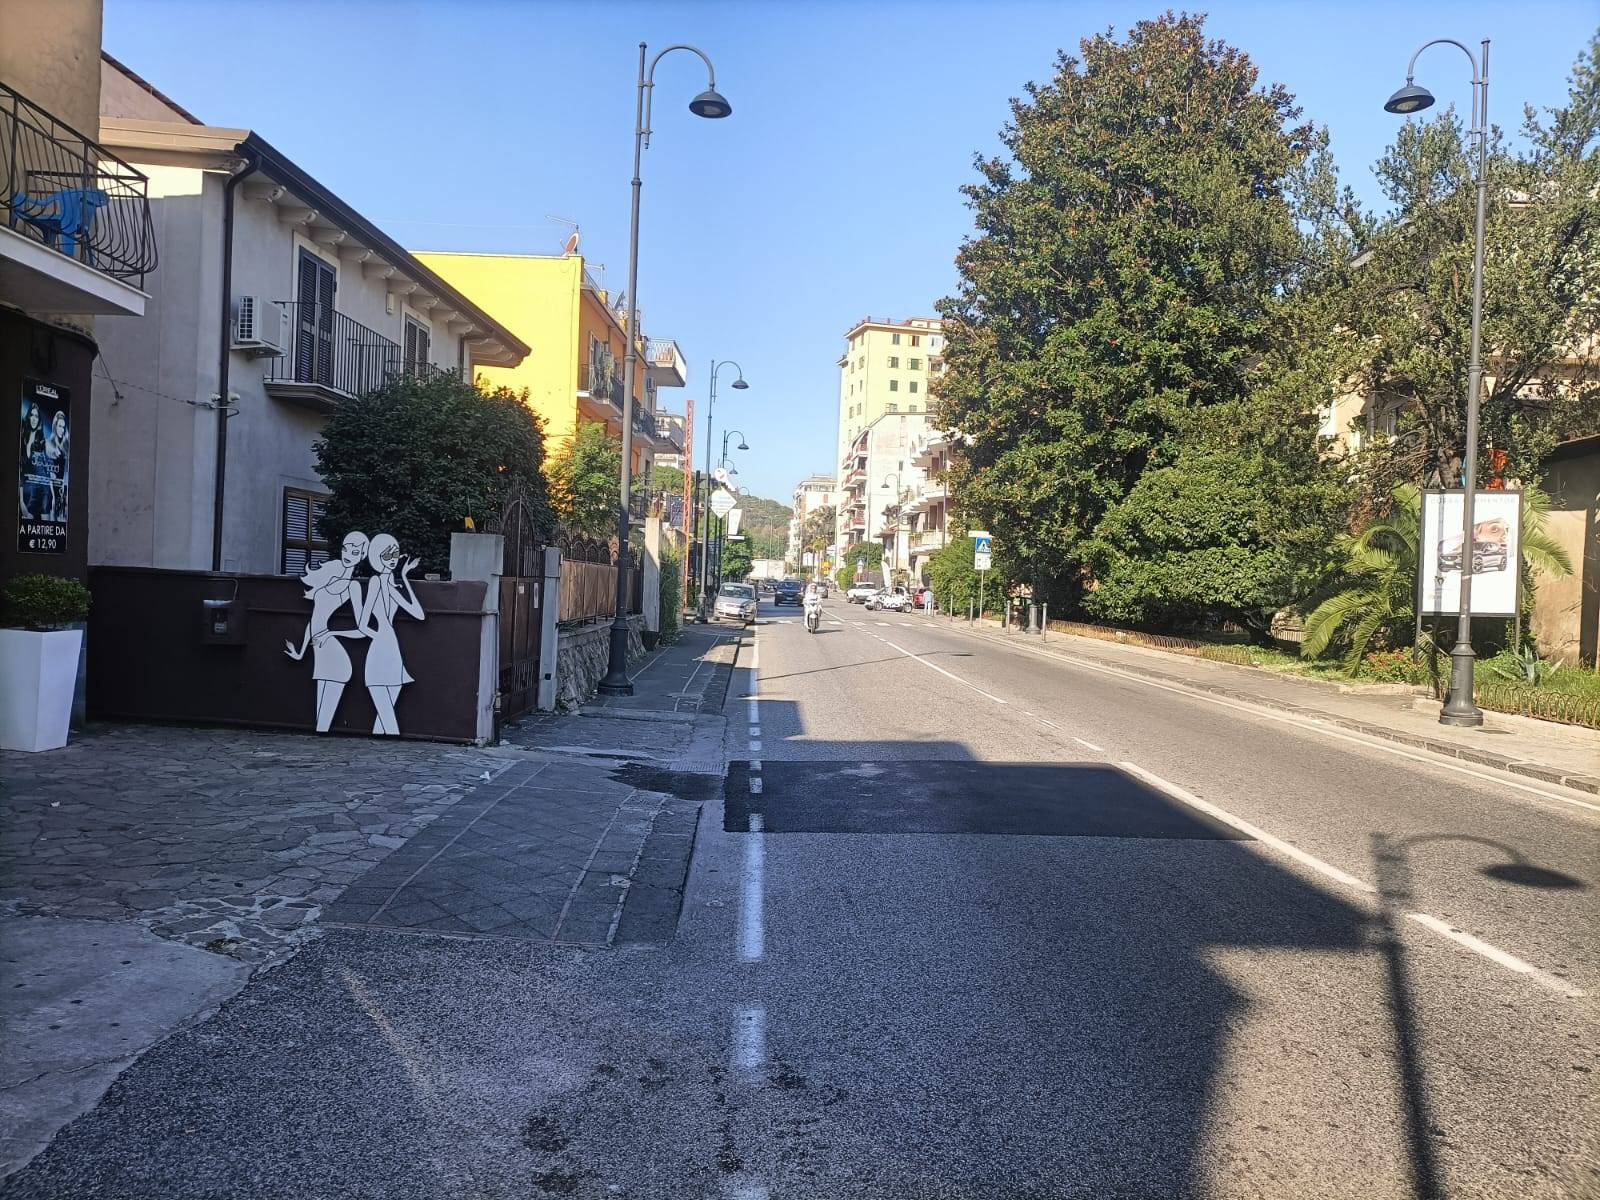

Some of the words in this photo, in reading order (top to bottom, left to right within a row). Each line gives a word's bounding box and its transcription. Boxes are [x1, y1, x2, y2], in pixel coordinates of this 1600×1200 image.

[19, 524, 26, 535] A
[27, 524, 54, 536] PARTIRE
[55, 525, 66, 537] DA
[29, 539, 36, 549] €
[37, 538, 57, 551] 12,90
